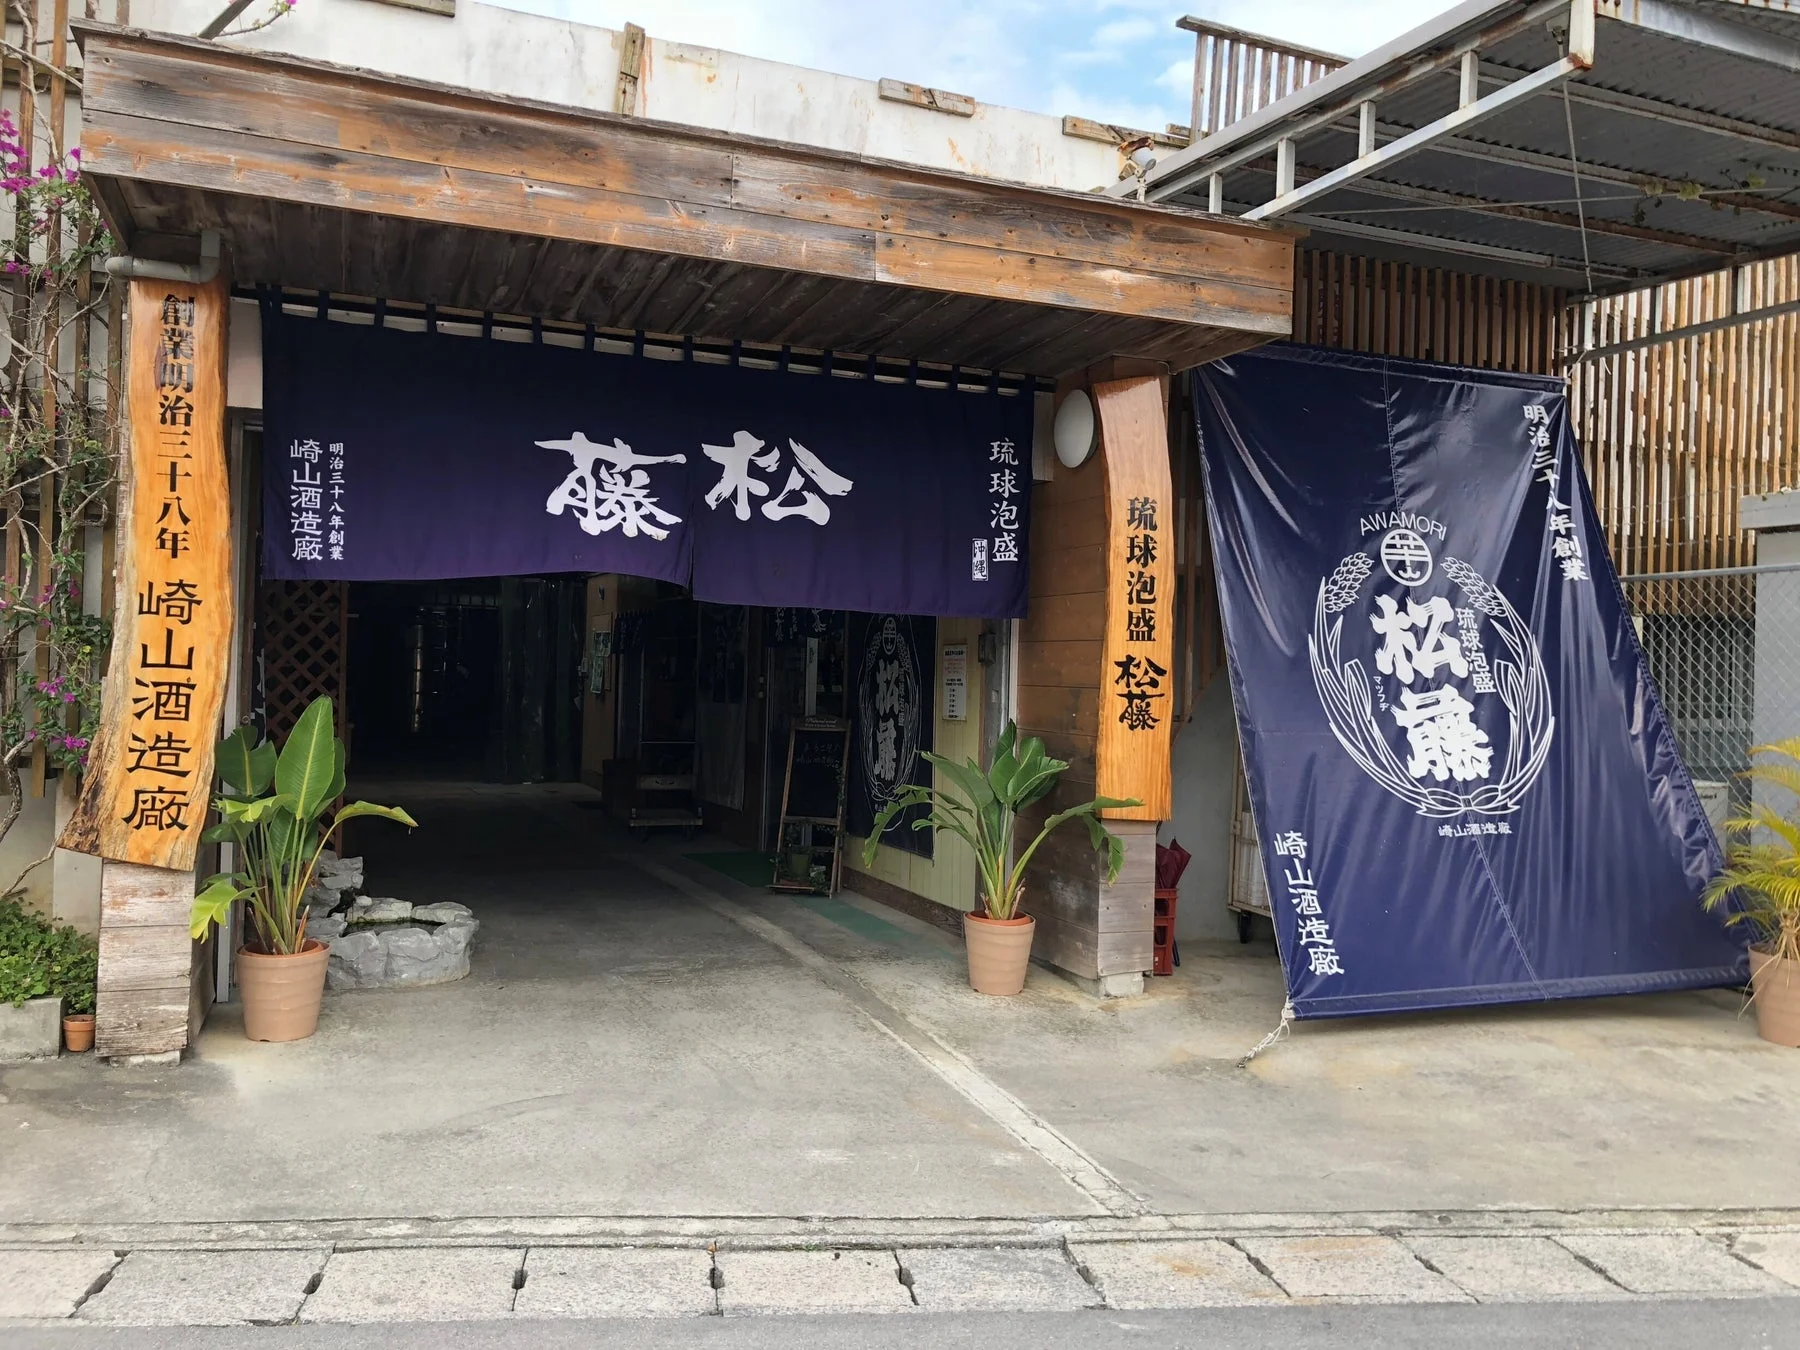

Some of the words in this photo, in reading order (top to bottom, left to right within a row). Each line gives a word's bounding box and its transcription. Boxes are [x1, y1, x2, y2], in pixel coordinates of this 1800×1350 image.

[155, 292, 195, 559] 創業明治三十八年
[290, 439, 323, 561] 崎山酒造廠
[328, 442, 345, 561] 明治三十八年創業
[988, 437, 1020, 562] 琉球泡盛
[1360, 511, 1447, 541] AWAMORI
[1523, 404, 1589, 581] 明治三十八年創業
[1126, 496, 1158, 642] 琉球泡盛
[123, 579, 202, 832] 崎山酒造廠
[1114, 654, 1168, 732] 松藤
[1369, 594, 1494, 782] 松藤
[1455, 607, 1497, 694] 琉球泡盛
[1438, 821, 1513, 837] 崎山酒造廠
[1274, 830, 1345, 976] 崎山酒造廠
